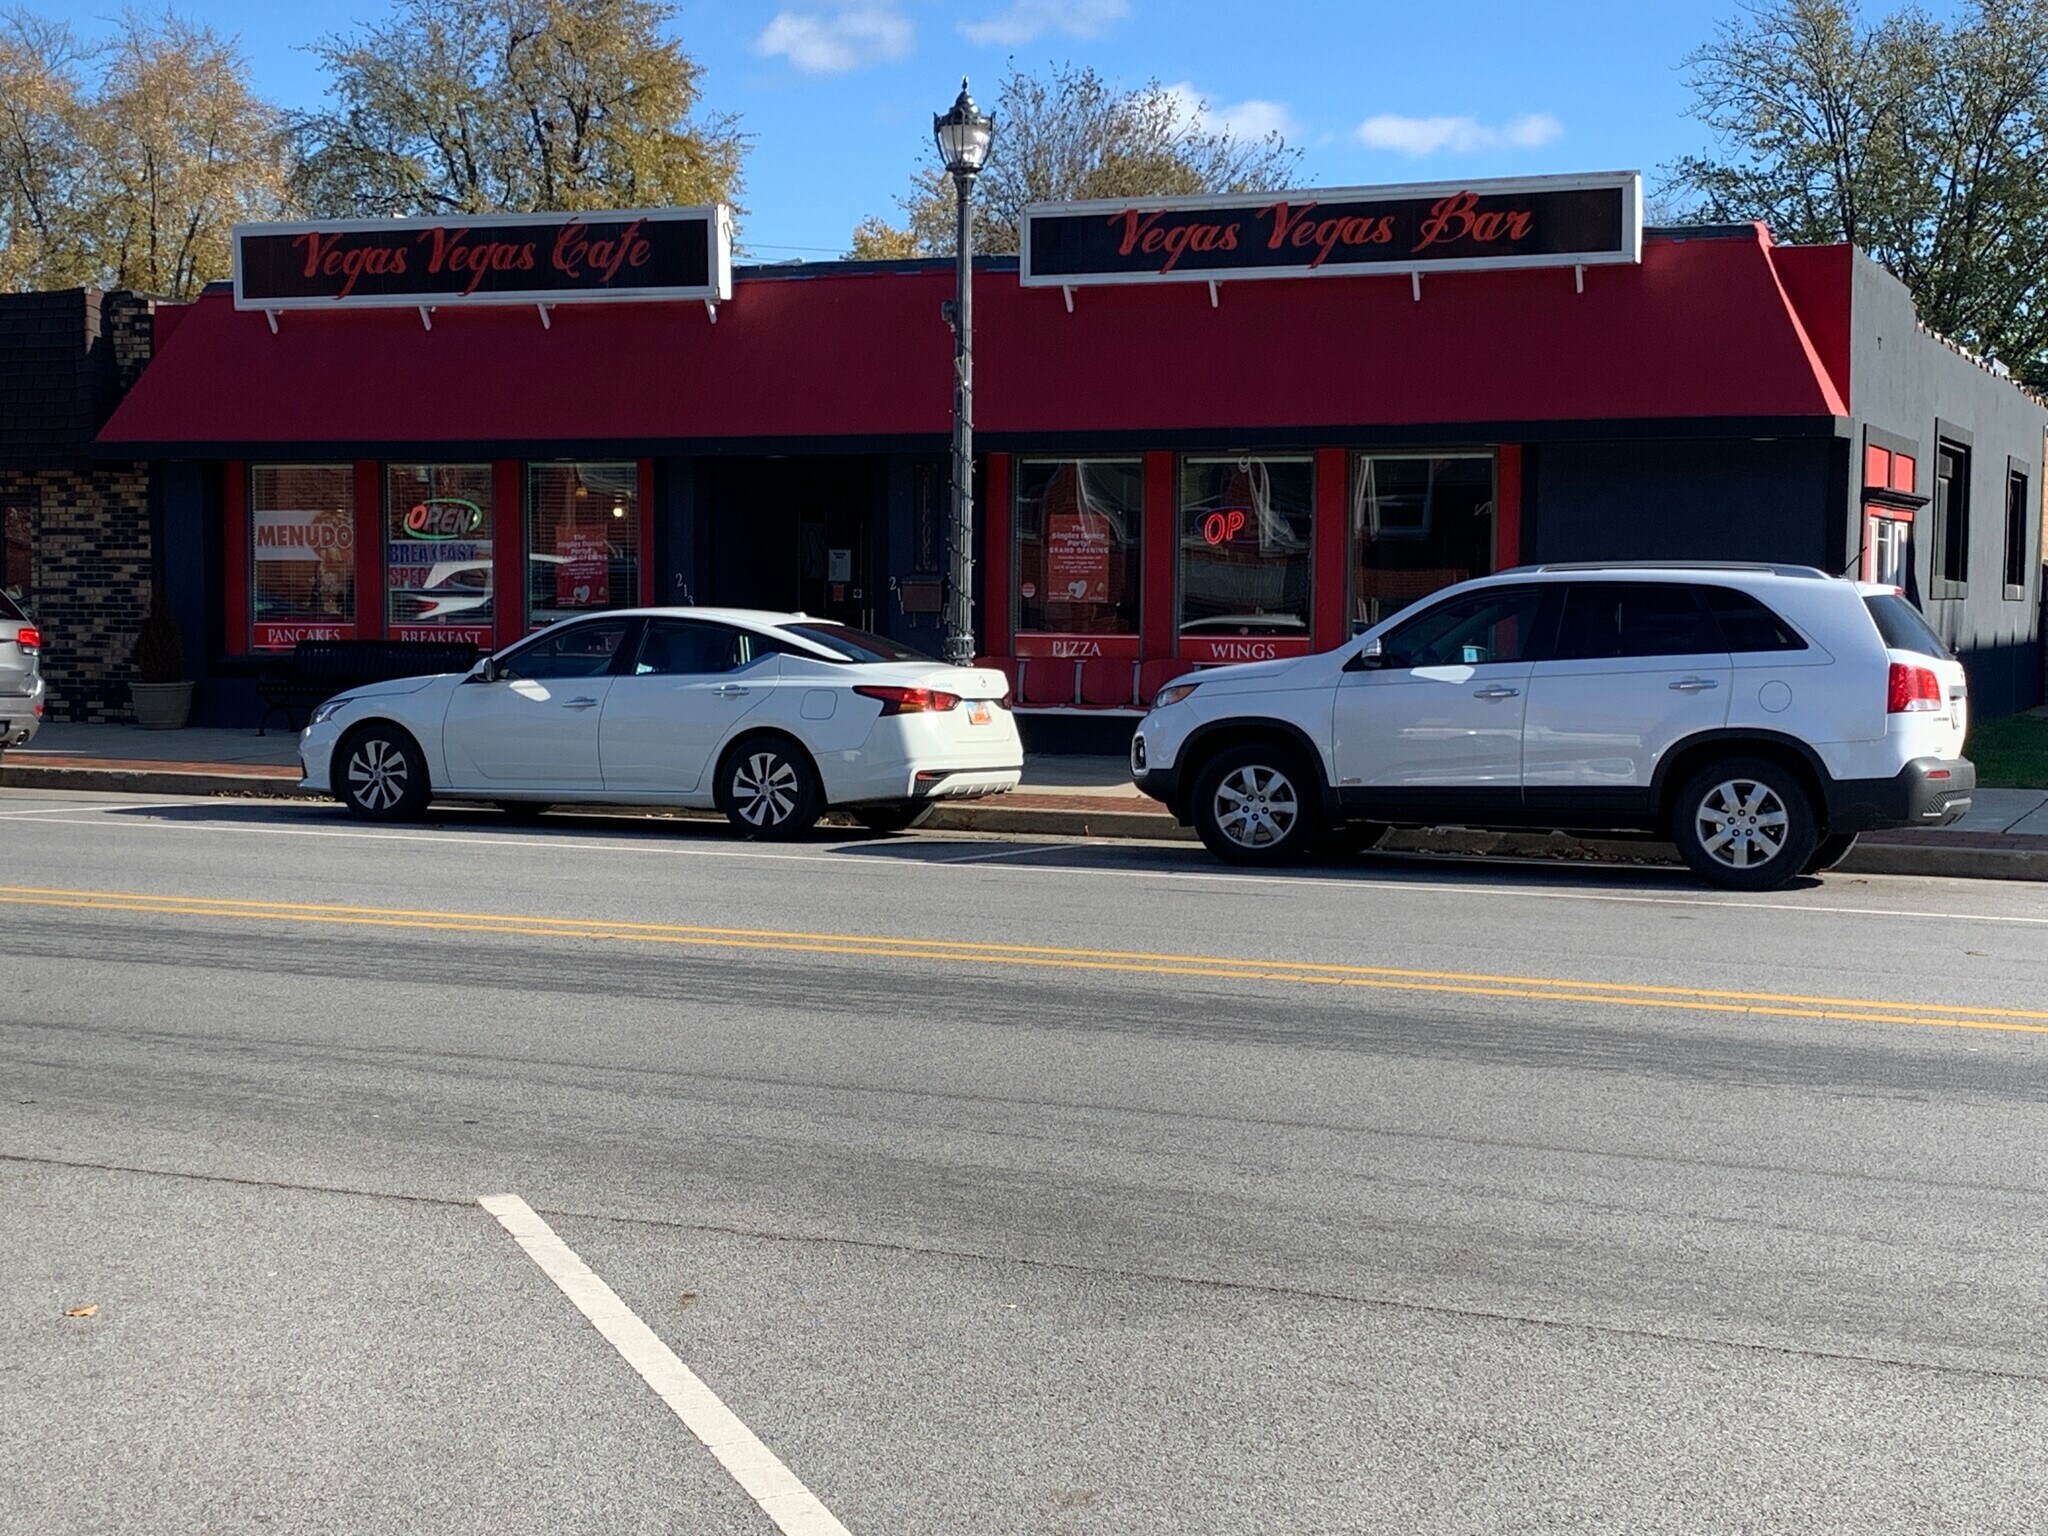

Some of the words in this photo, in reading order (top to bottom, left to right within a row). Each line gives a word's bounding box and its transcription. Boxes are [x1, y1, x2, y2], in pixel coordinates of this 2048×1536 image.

[1107, 209, 1241, 275] Vegas
[1256, 201, 1395, 269] Vegas
[1411, 190, 1532, 253] Bar
[292, 231, 407, 299] Vegas
[416, 226, 536, 296] Vegas
[408, 504, 474, 533] OPEN
[256, 523, 355, 549] MENUDO
[390, 543, 478, 563] BREAKFAST
[390, 567, 453, 588] SPEC
[267, 628, 341, 642] PANCAKES
[400, 630, 482, 644] BREAKFAST
[1052, 641, 1102, 657] PIZZA
[1210, 643, 1276, 660] WINGS
